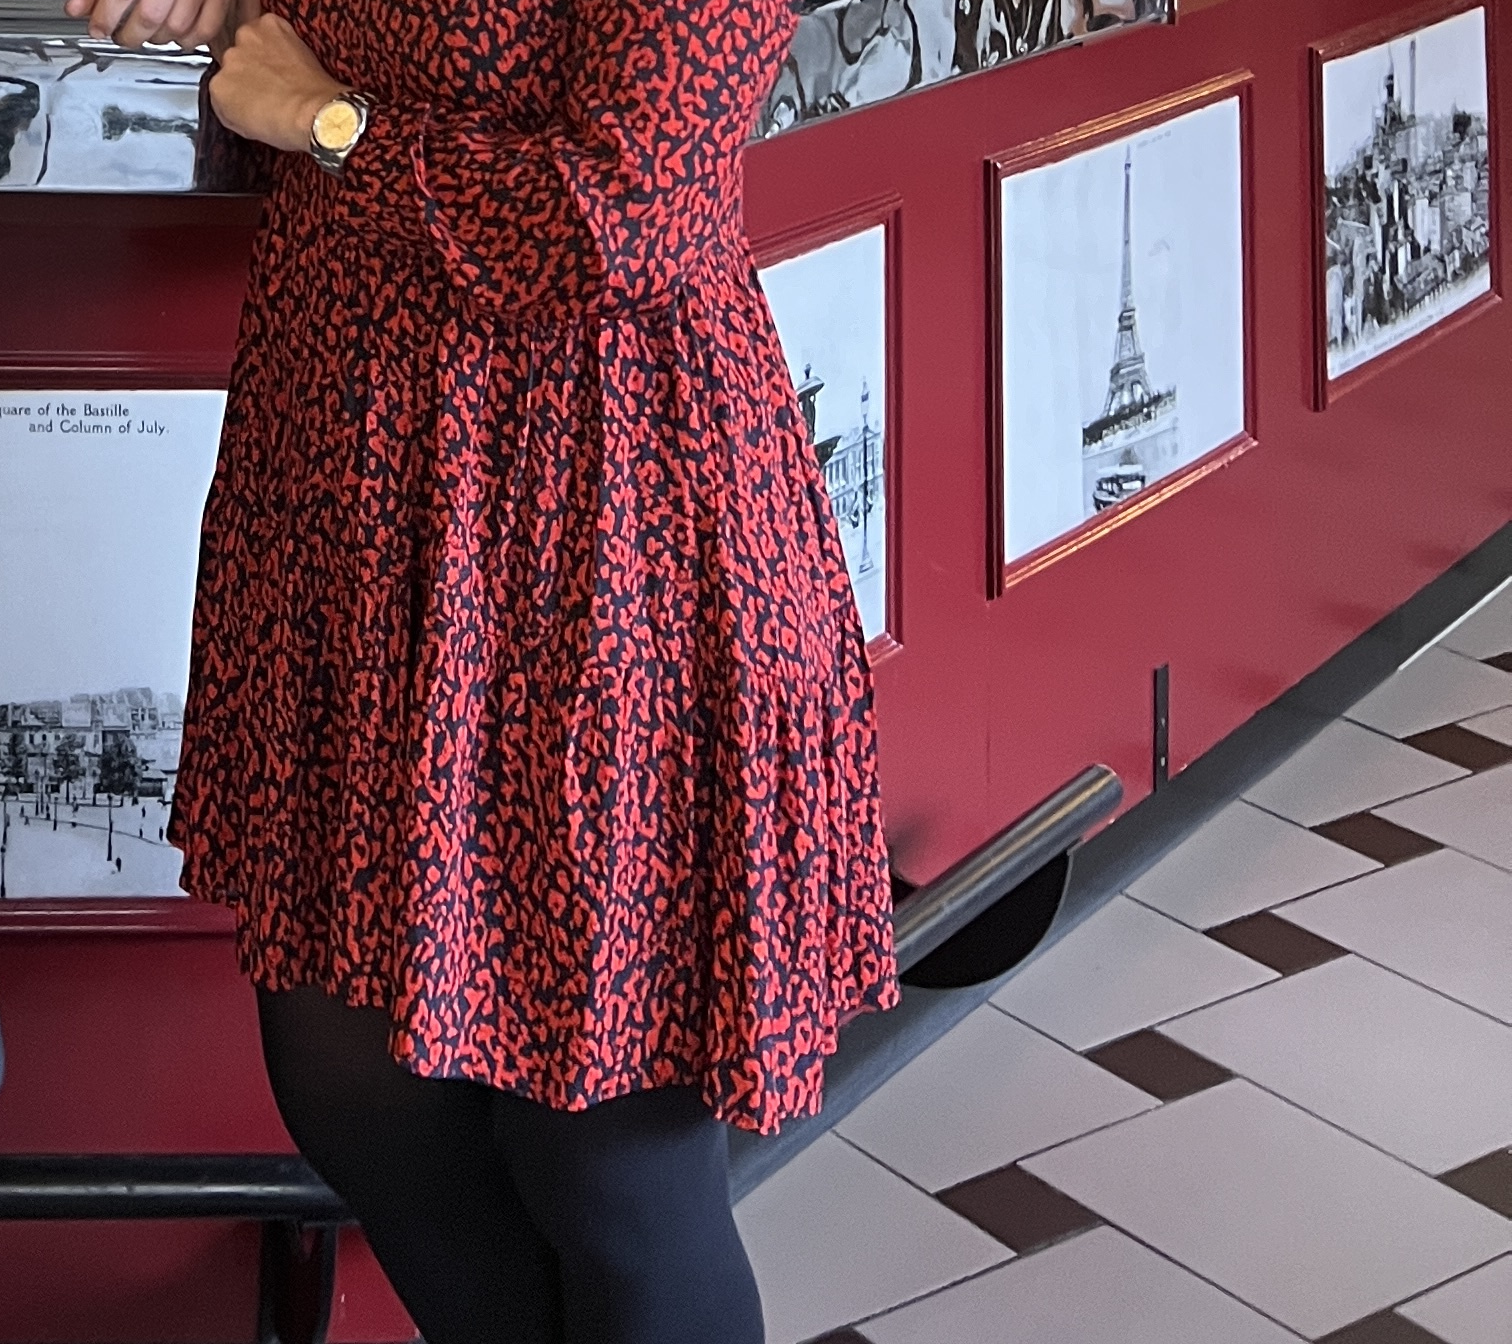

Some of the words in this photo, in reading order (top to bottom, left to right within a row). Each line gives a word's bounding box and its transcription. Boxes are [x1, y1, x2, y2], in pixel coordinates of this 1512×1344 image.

[37, 402, 51, 416] of
[56, 402, 77, 417] the
[83, 403, 130, 417] Bastille
[28, 419, 53, 433] and
[59, 419, 112, 434] Column
[118, 419, 133, 434] of
[137, 420, 170, 437] July.
